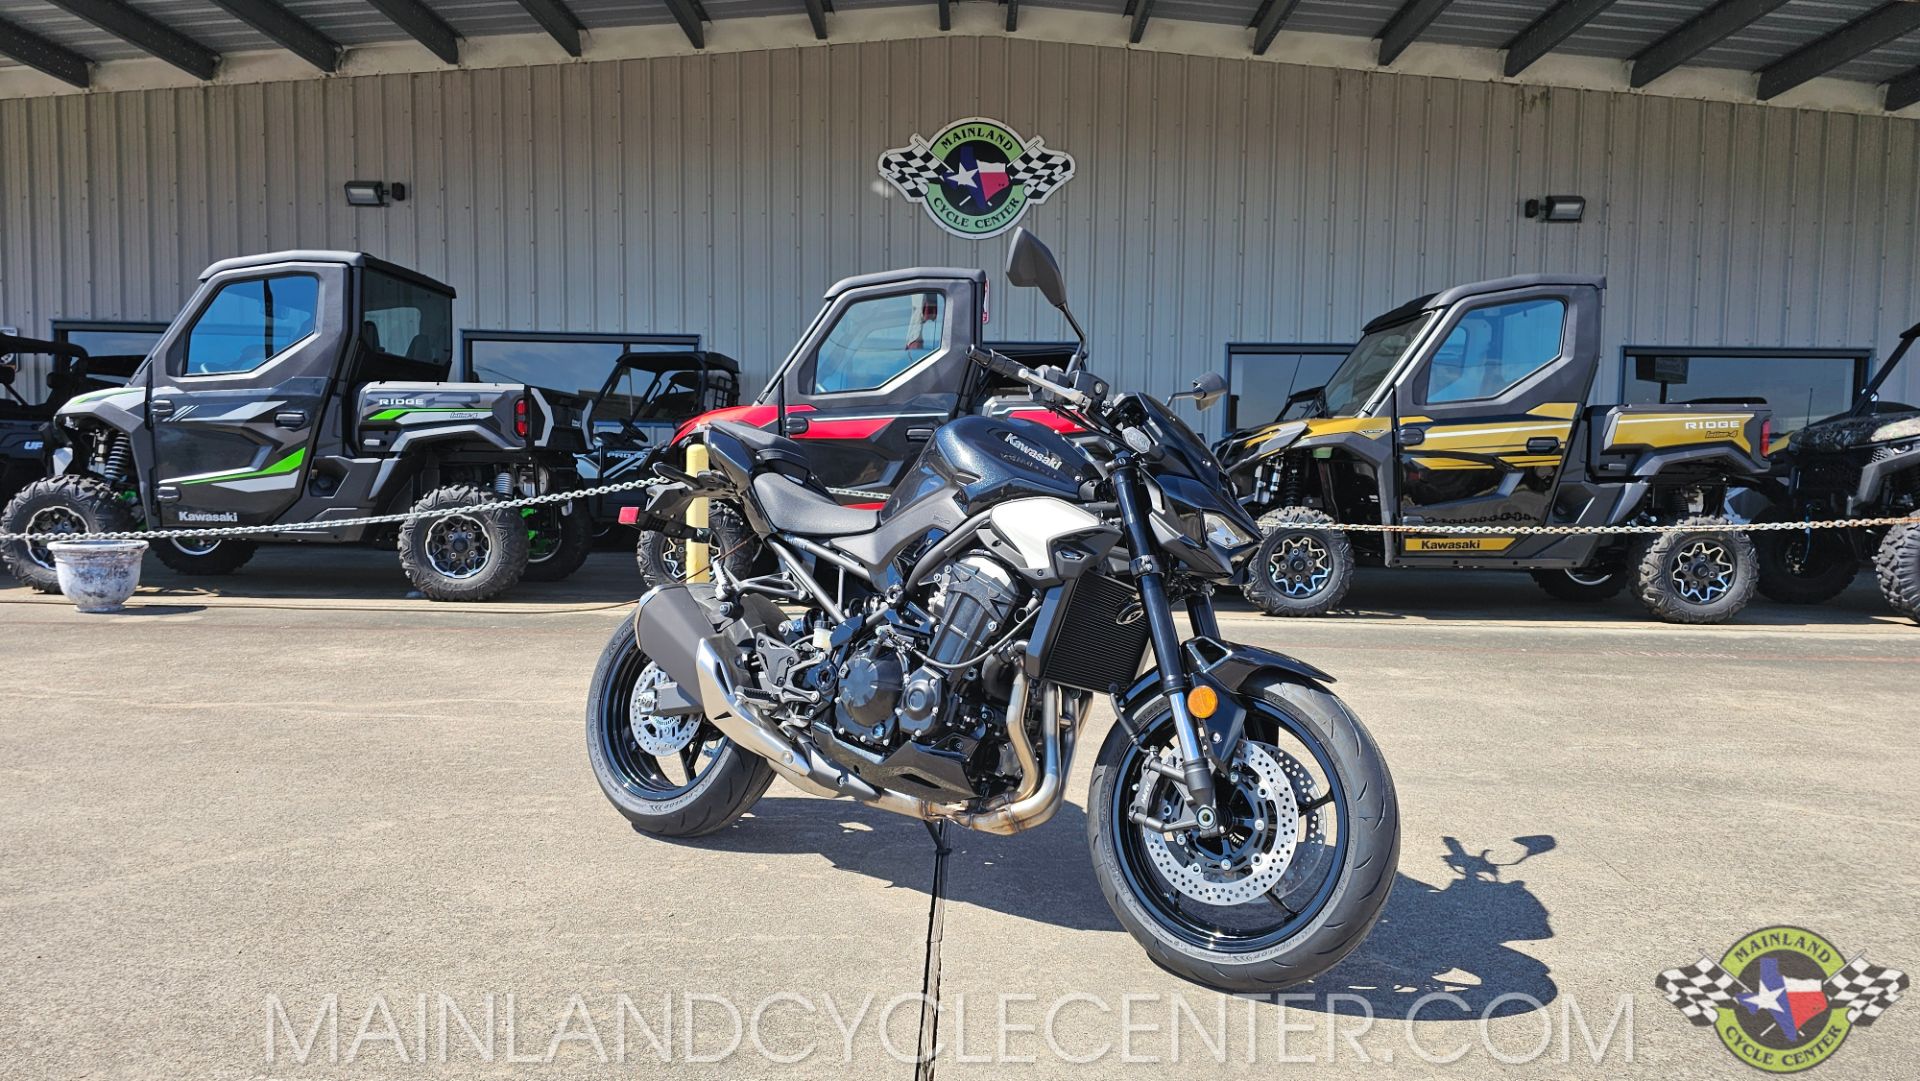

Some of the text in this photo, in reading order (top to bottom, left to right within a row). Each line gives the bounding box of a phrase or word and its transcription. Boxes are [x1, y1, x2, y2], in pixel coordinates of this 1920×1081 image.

[941, 127, 1014, 151] MAINLAND
[933, 196, 1020, 229] CYCLE CENTER
[379, 398, 425, 406] RIDGE
[1685, 420, 1740, 429] RIDGE
[1004, 432, 1063, 471] Kawasaki
[178, 511, 238, 522] Kawasaki
[1421, 540, 1481, 549] Kawasaki
